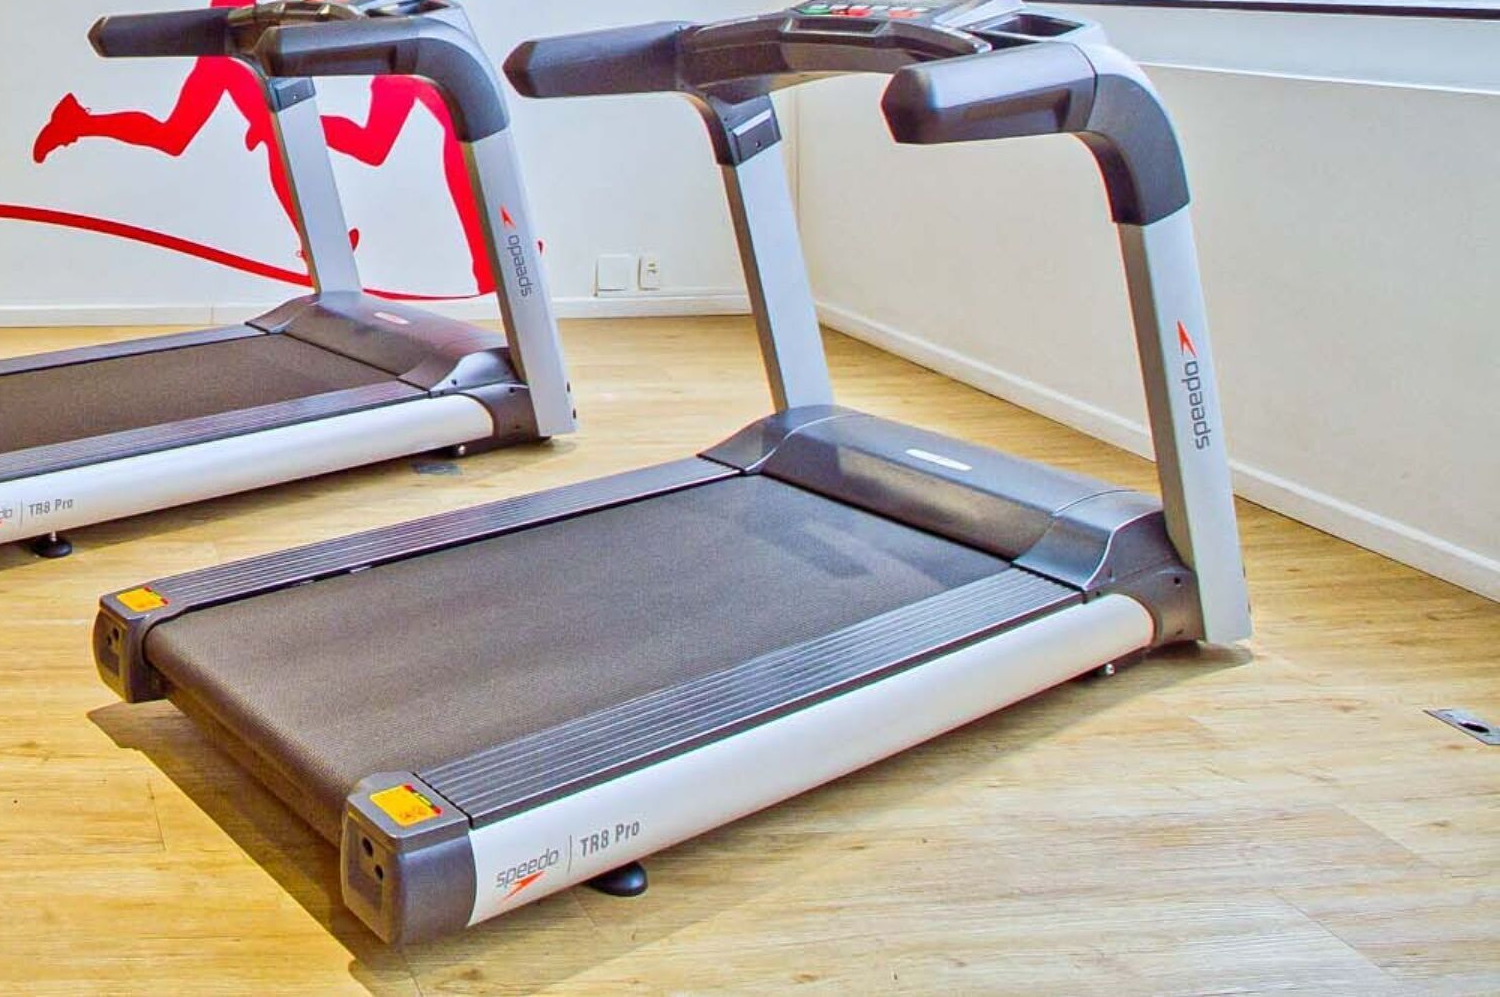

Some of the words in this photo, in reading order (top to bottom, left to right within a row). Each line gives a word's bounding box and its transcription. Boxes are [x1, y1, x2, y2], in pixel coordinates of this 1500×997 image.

[507, 234, 533, 298] speedo
[1181, 360, 1211, 451] speedo
[495, 847, 559, 889] speedo
[579, 829, 610, 858] TR8
[615, 820, 641, 843] Pro
